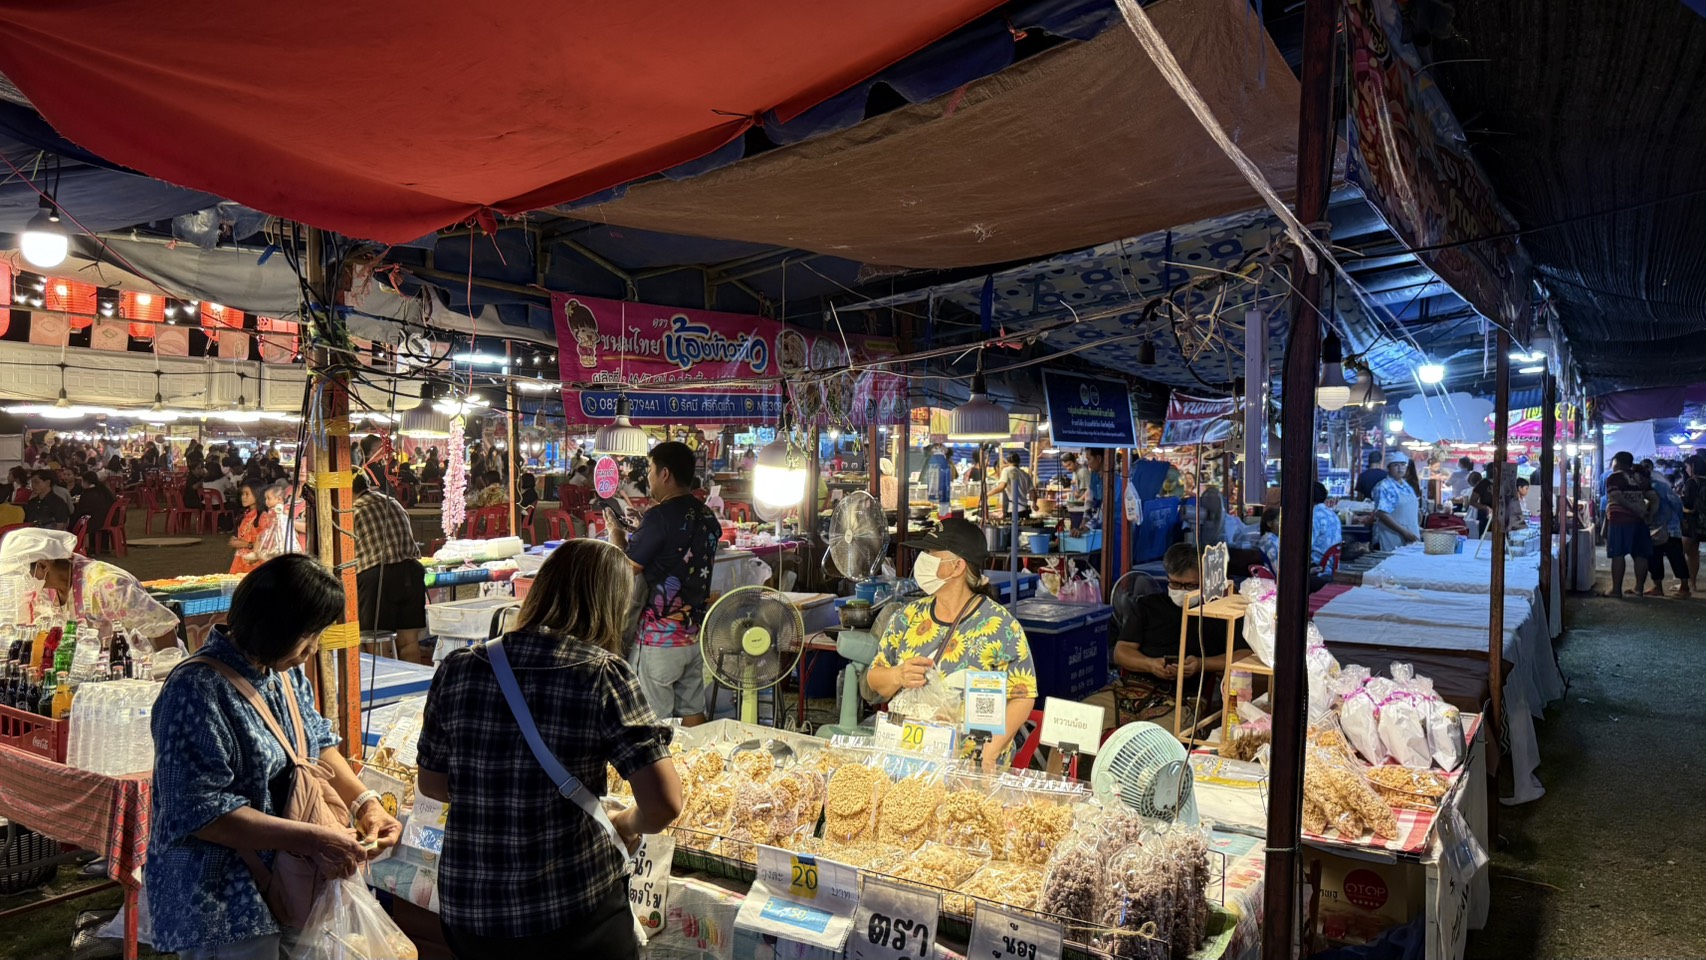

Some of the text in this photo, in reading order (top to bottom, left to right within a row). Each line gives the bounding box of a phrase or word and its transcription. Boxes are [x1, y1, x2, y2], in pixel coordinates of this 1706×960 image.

[601, 325, 661, 355] ขนมไทย
[902, 725, 924, 745] 20
[1054, 717, 1088, 729] หวานน้อย
[791, 864, 818, 890] 20
[831, 887, 851, 899] บาท
[1345, 882, 1387, 897] OTOP
[629, 882, 662, 909] ตงโม
[791, 908, 807, 921] 50
[868, 913, 928, 957] ตรา
[1002, 922, 1038, 960] น้อง
